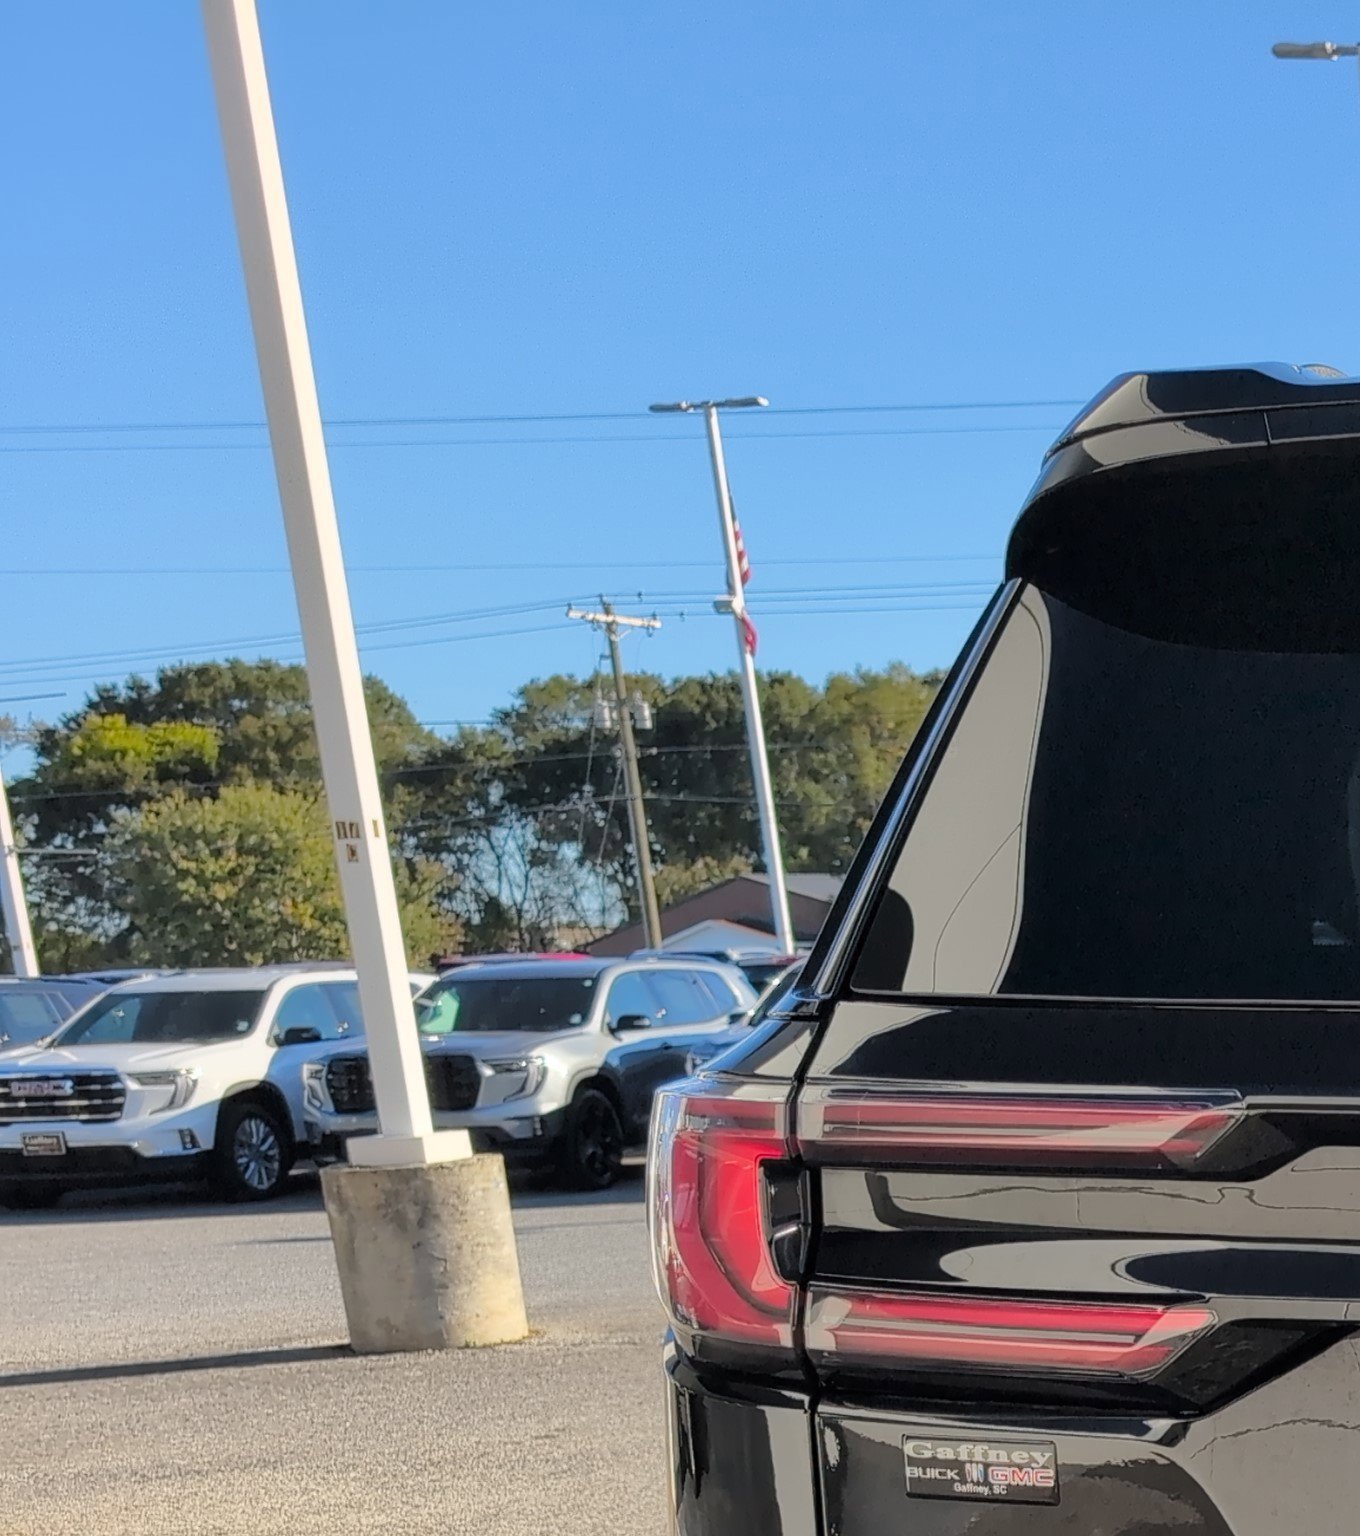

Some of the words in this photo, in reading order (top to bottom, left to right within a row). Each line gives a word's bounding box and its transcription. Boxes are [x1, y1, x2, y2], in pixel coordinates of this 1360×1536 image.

[903, 1441, 1053, 1468] Gaffney
[906, 1466, 961, 1481] BUICK
[987, 1466, 1055, 1487] GMC
[993, 1484, 1007, 1495] SC
